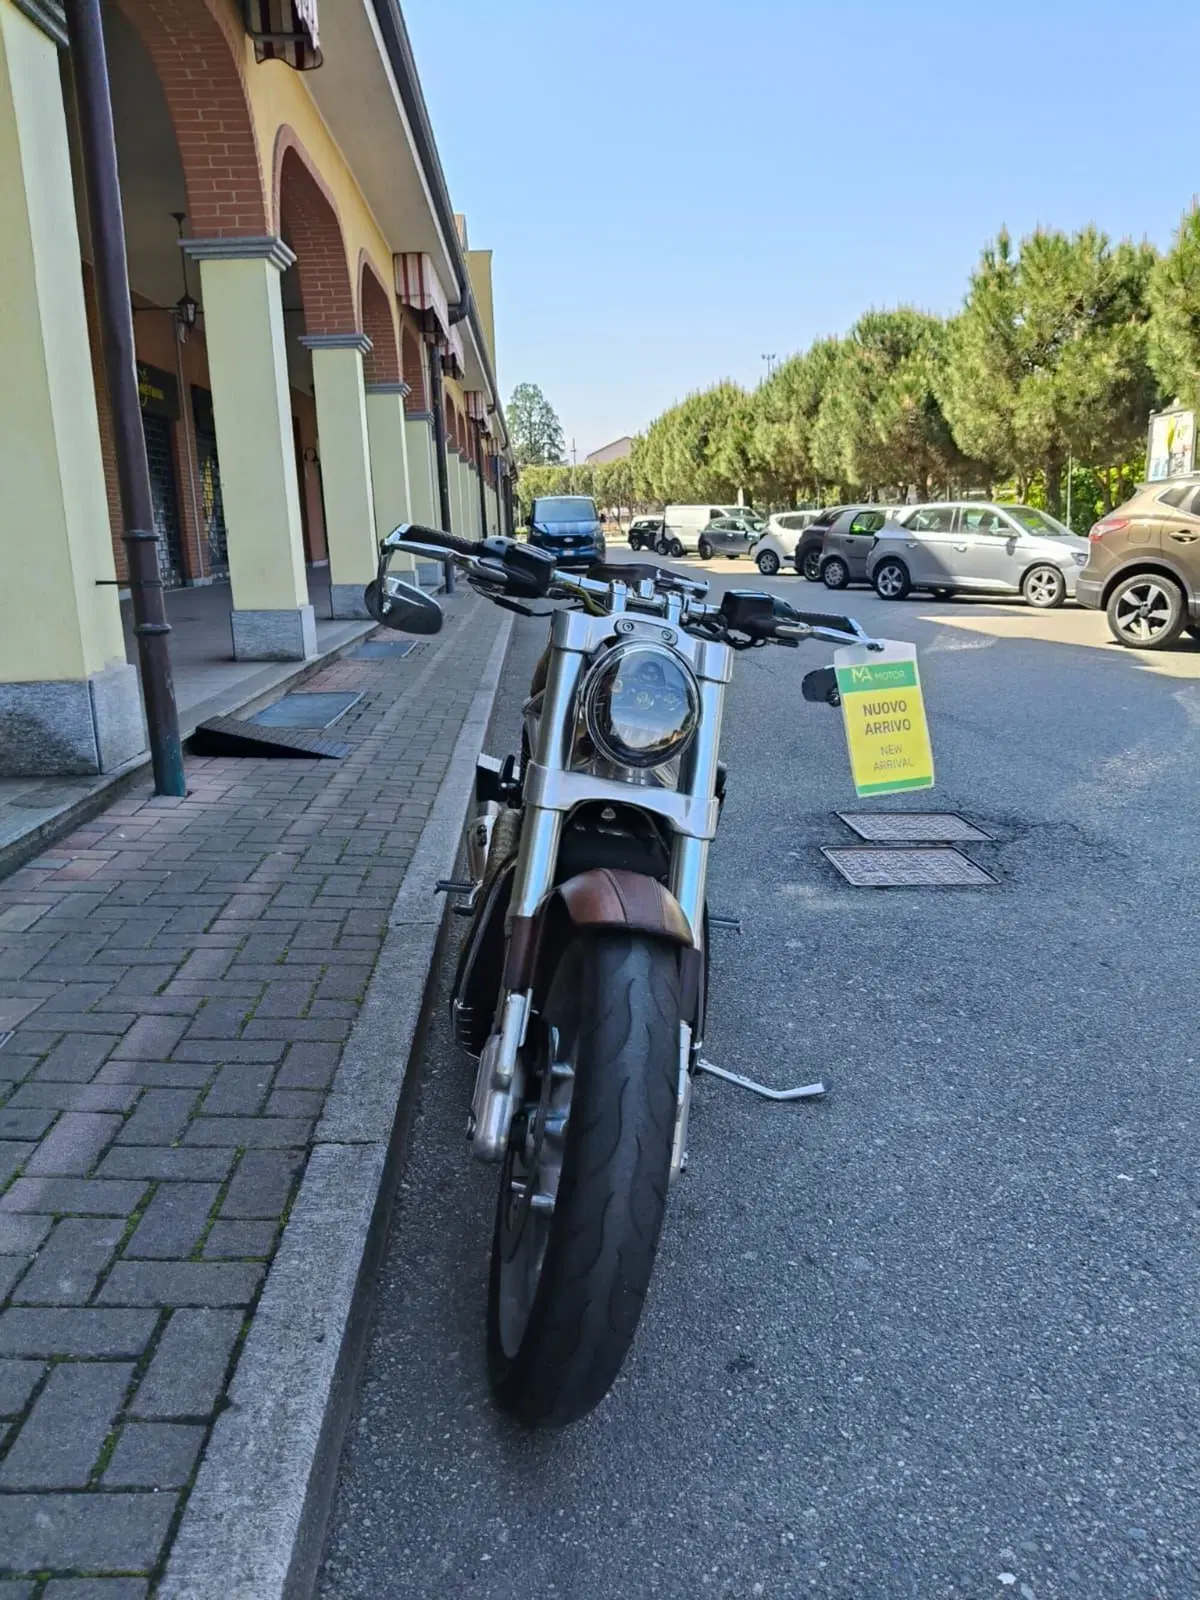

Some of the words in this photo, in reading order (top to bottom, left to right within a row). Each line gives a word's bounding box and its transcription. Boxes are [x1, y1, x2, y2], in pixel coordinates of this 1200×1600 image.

[874, 670, 905, 681] MOTOR
[863, 700, 907, 716] NUOVO
[865, 719, 911, 736] ARRIVO
[880, 744, 902, 756] NEW
[873, 758, 914, 772] ARRIVAL
